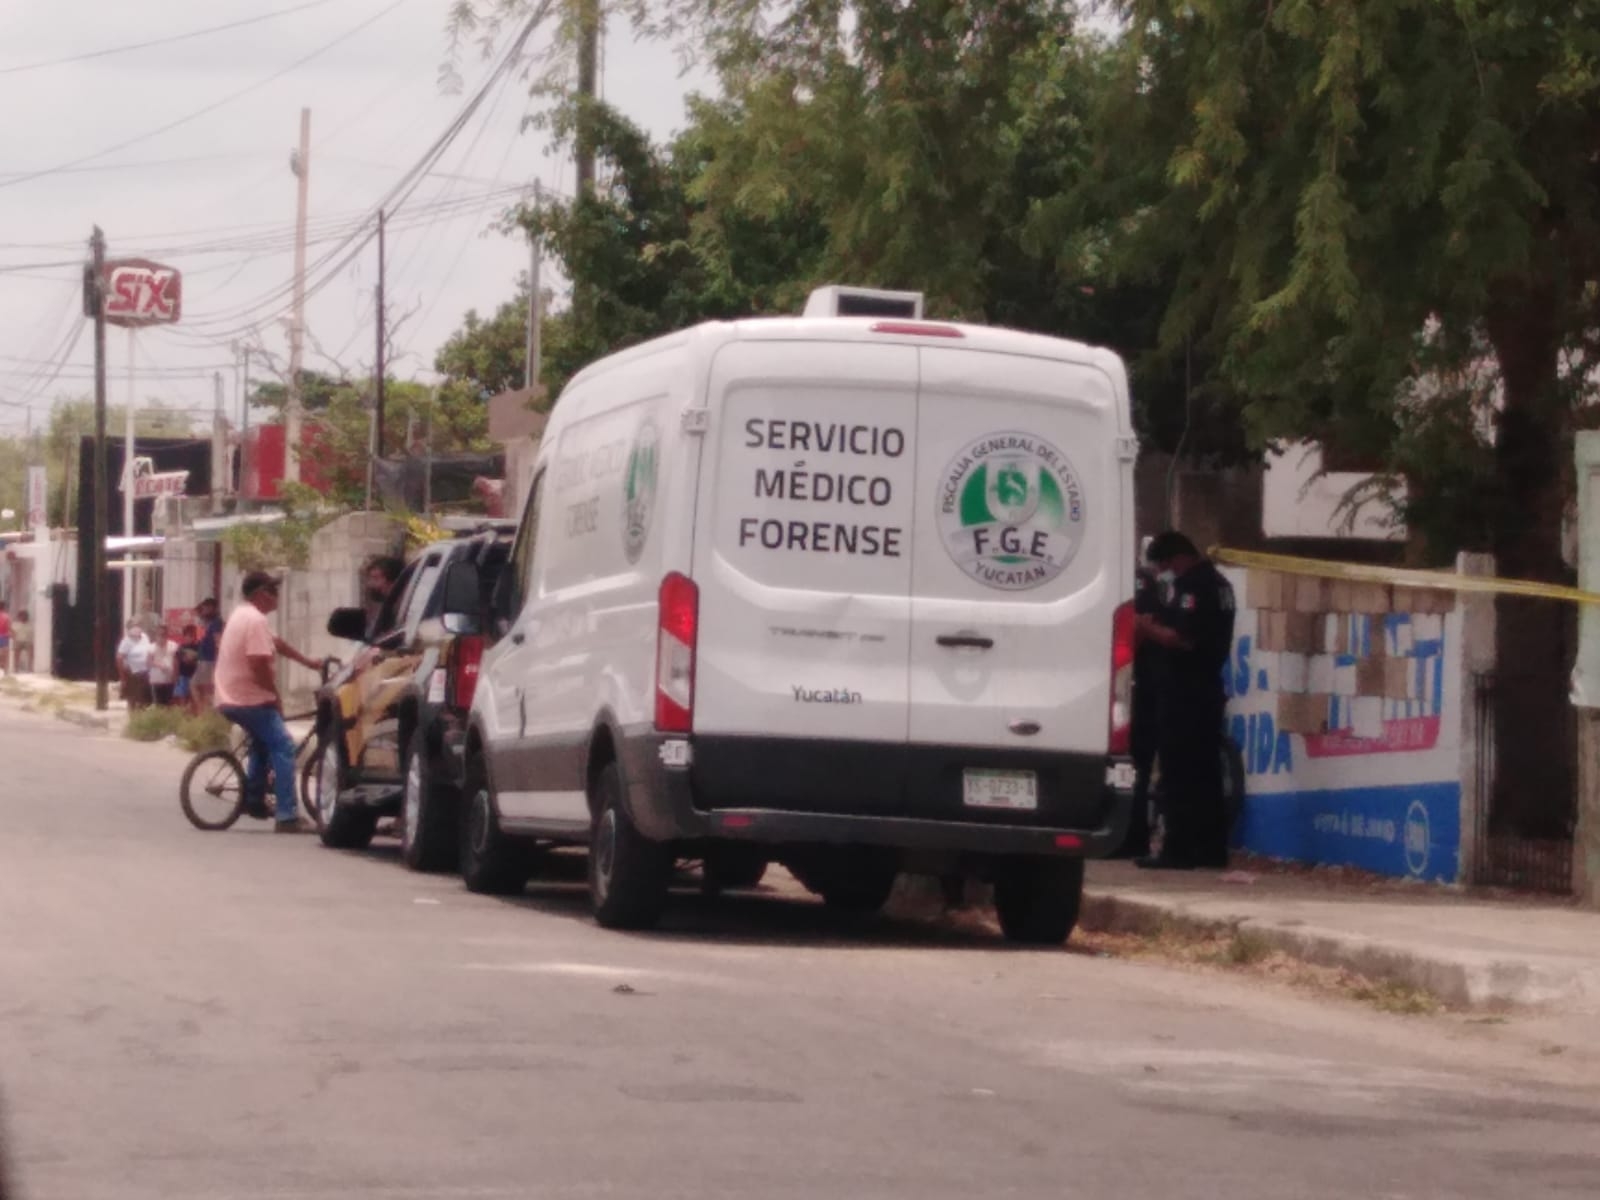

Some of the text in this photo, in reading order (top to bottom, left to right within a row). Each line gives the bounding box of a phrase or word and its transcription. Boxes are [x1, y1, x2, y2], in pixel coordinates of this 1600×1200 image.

[745, 418, 905, 458] SERVICIO
[754, 460, 892, 507] MÉDICO
[971, 437, 1034, 459] GENERAL
[1035, 444, 1059, 468] DEL
[1057, 465, 1080, 522] ESTADO
[738, 517, 903, 558] FORENSE
[792, 684, 862, 704] Yucatán
